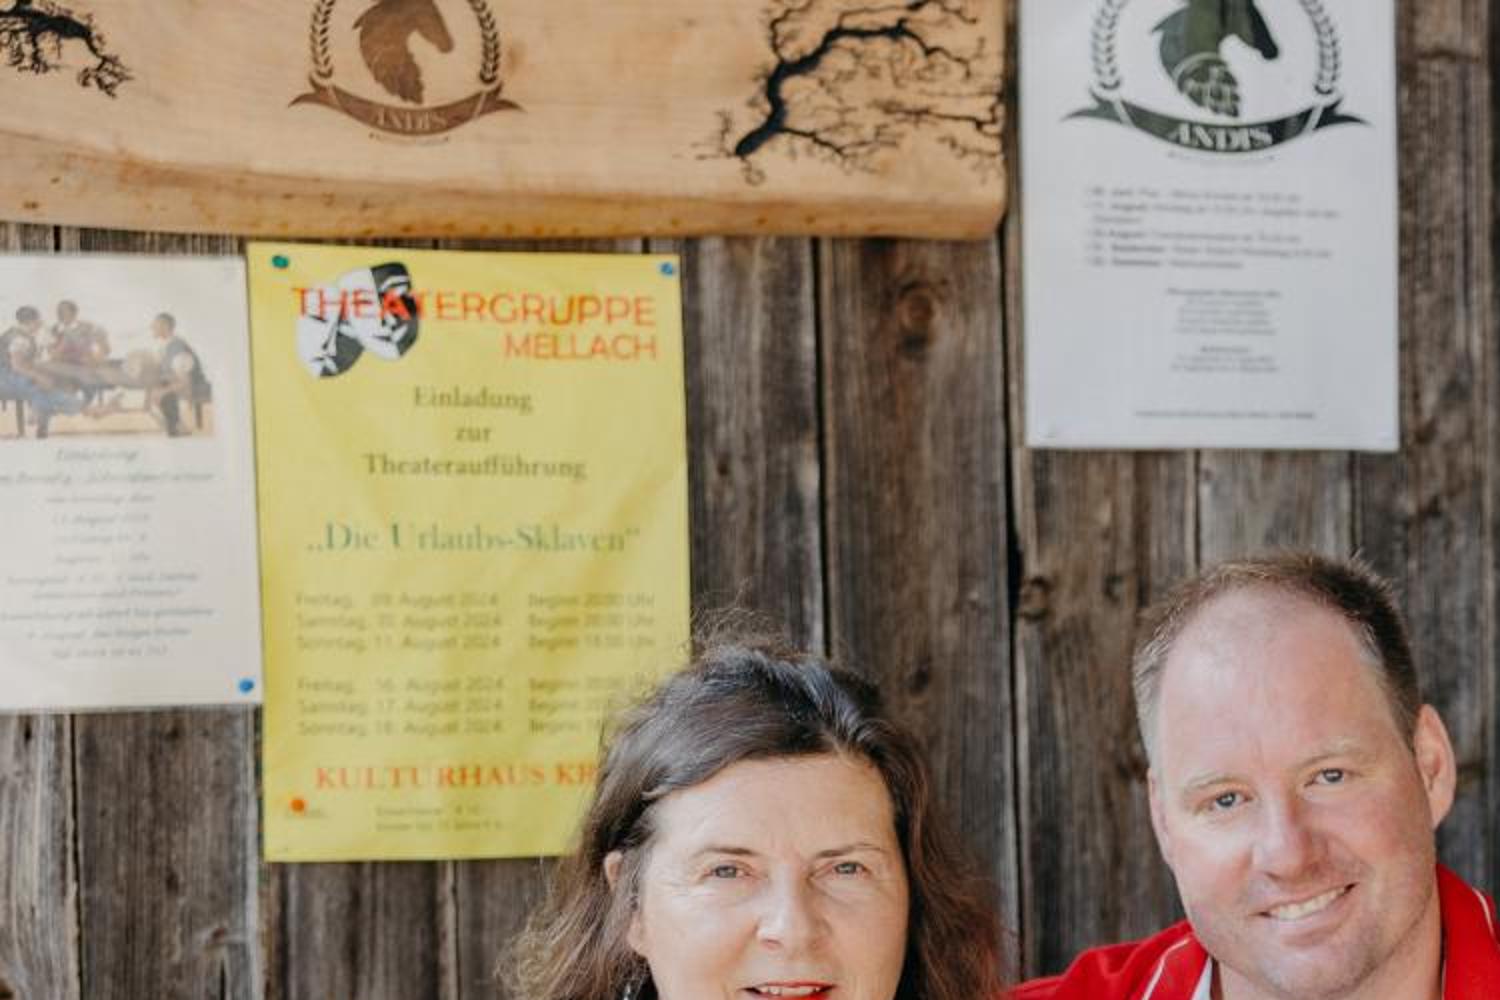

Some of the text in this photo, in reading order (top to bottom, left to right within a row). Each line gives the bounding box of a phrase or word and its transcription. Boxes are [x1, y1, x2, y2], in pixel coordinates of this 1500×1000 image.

[293, 286, 656, 326] THEATERGRUPPE
[504, 333, 657, 361] MELLACH
[413, 385, 533, 413] Einladung
[455, 425, 492, 443] zur
[363, 453, 587, 481] Theateraufführung
